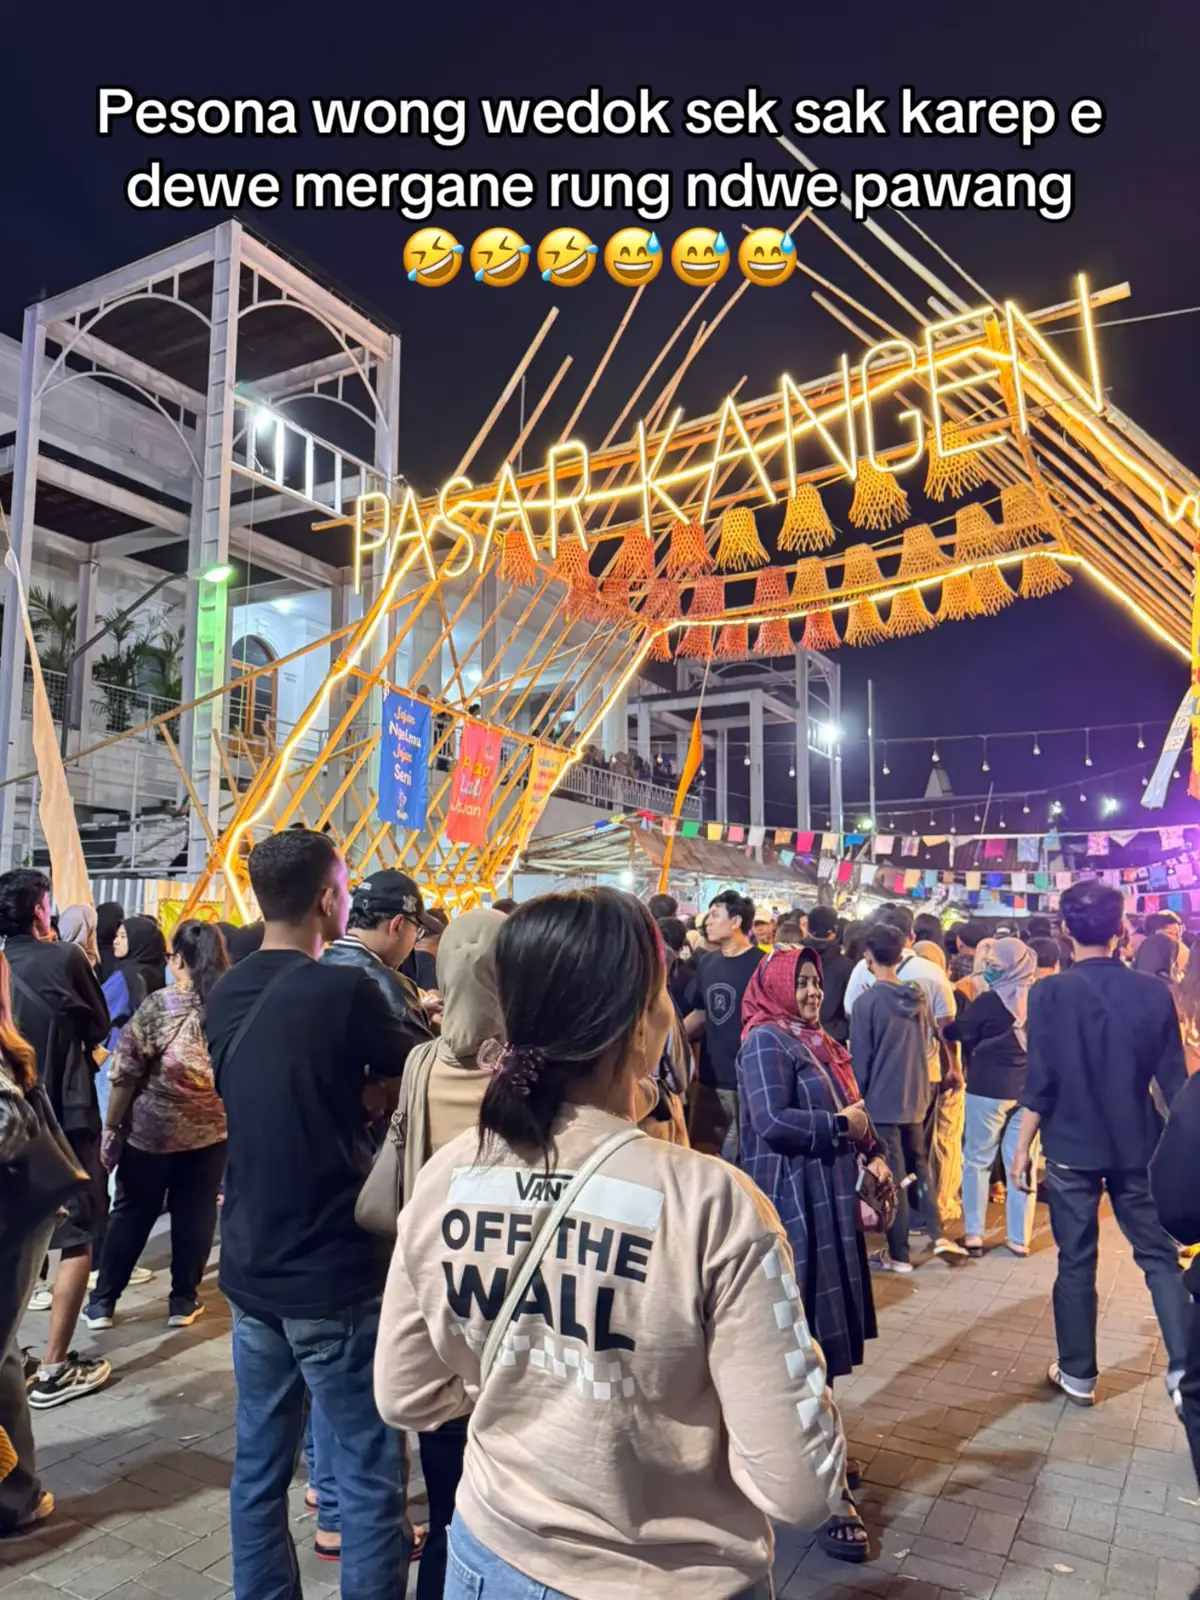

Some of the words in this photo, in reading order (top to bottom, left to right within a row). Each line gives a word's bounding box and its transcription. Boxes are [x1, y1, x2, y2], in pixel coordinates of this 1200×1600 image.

[353, 440, 590, 596] PASAR
[638, 272, 1105, 538] KANGEN
[515, 1171, 575, 1202] VAN
[441, 1208, 534, 1256] OFF
[555, 1216, 654, 1284] THE
[441, 1261, 636, 1352] WALL
